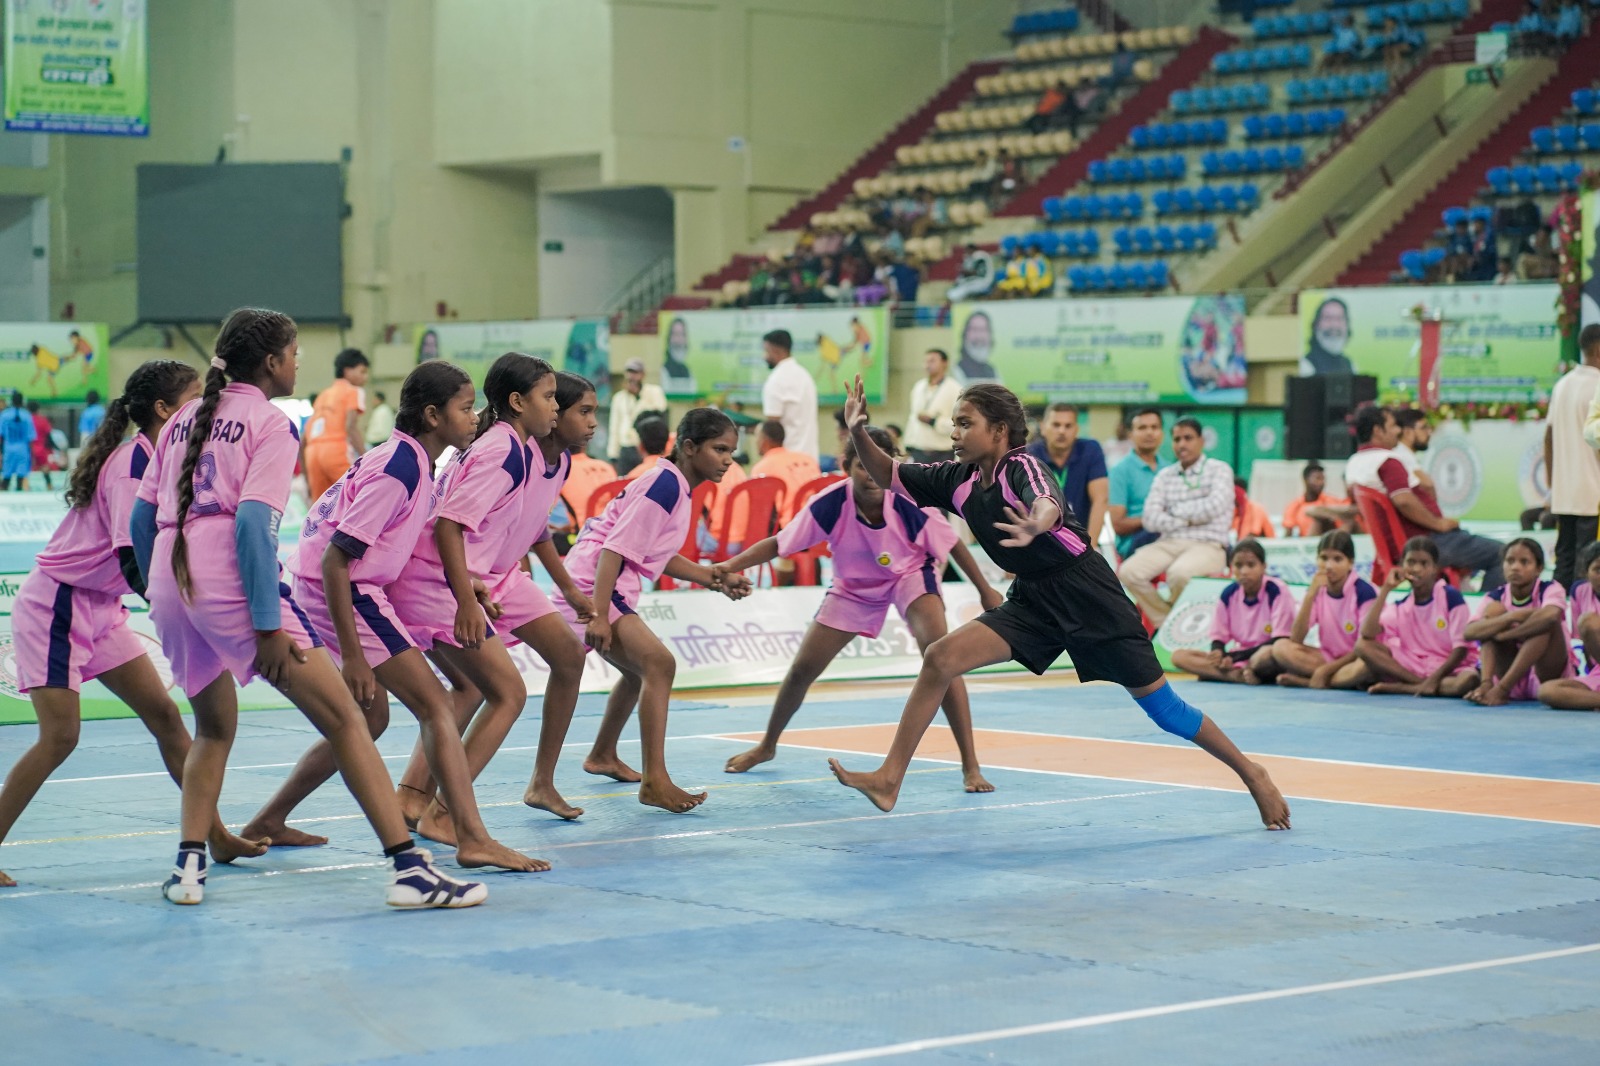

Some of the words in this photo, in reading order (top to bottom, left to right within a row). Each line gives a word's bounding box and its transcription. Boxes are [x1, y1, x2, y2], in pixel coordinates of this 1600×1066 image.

[171, 418, 245, 446] DHBAD
[190, 450, 221, 515] 2
[669, 622, 805, 668] प्रतियोगित
